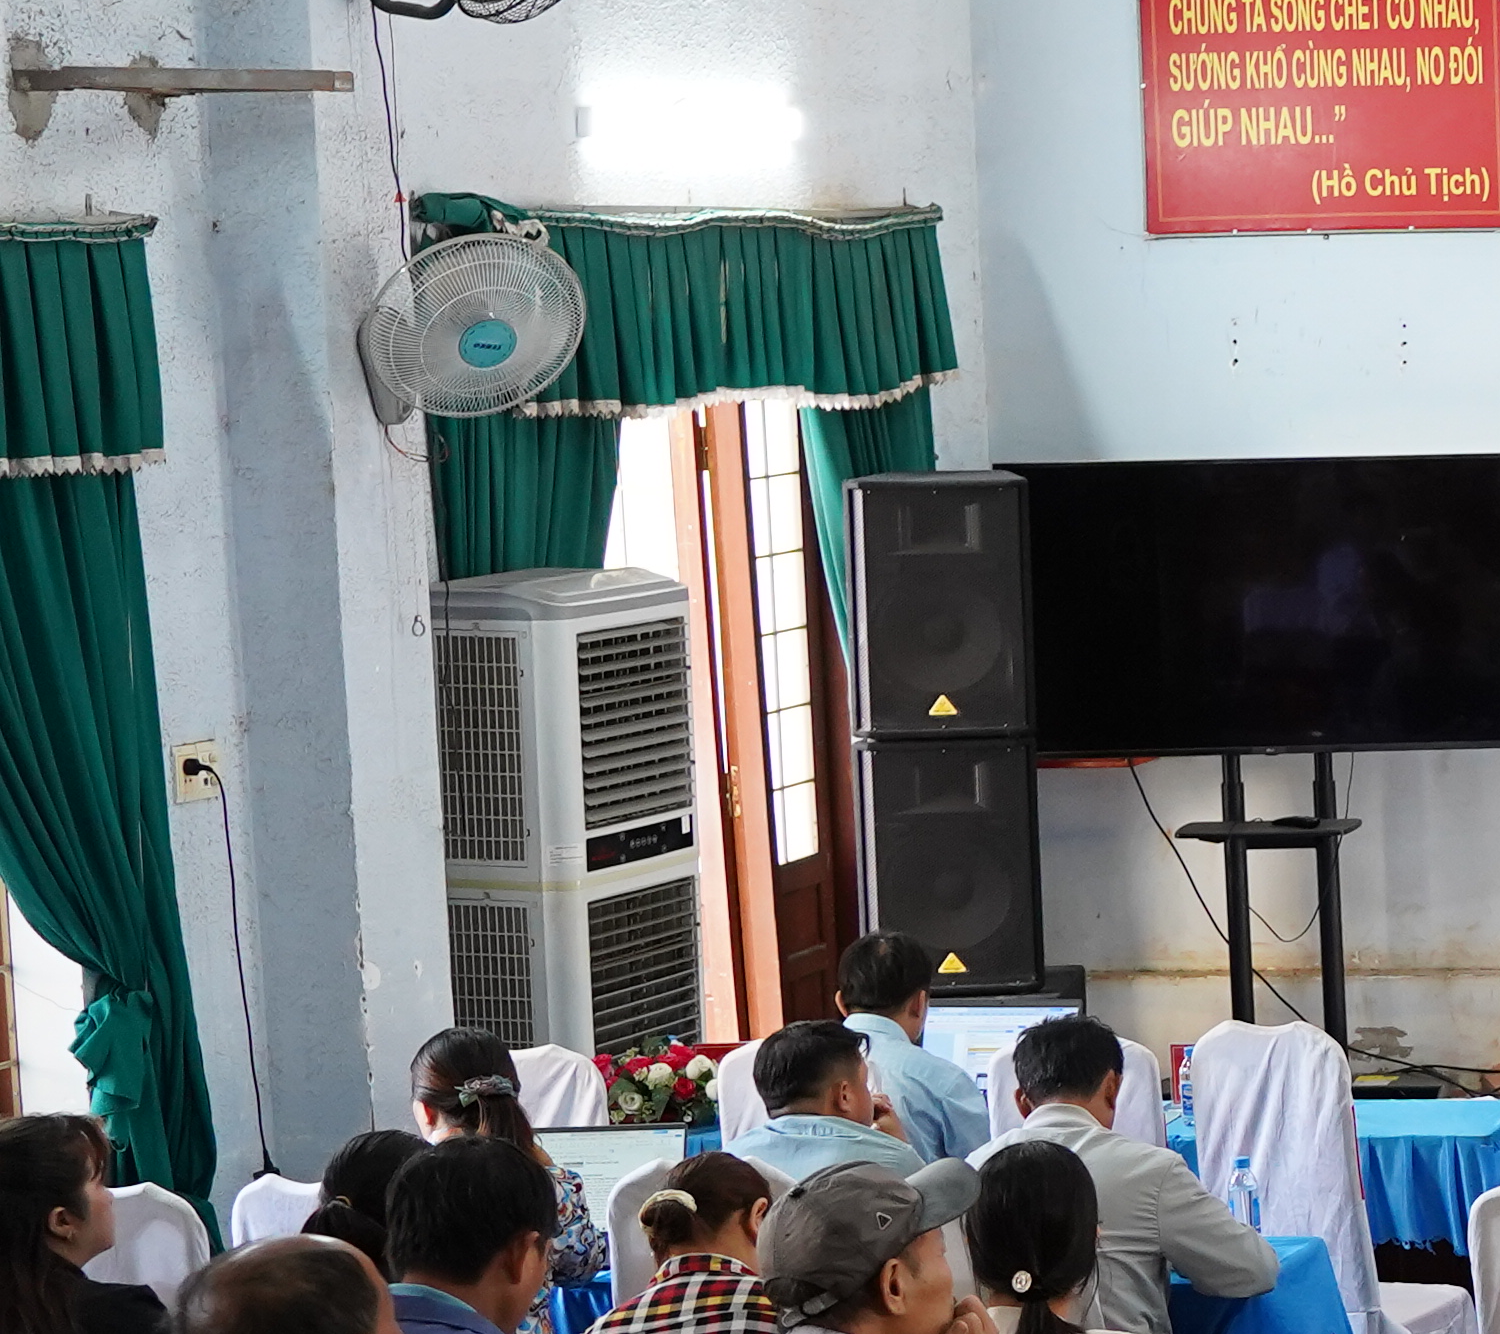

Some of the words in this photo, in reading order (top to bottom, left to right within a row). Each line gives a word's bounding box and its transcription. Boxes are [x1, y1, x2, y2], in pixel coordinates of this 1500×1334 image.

[1172, 100, 1232, 147] GIÚP
[1312, 163, 1357, 204] (Hồ
[1365, 168, 1417, 196] Chủ
[1424, 167, 1489, 201] Tịch)
